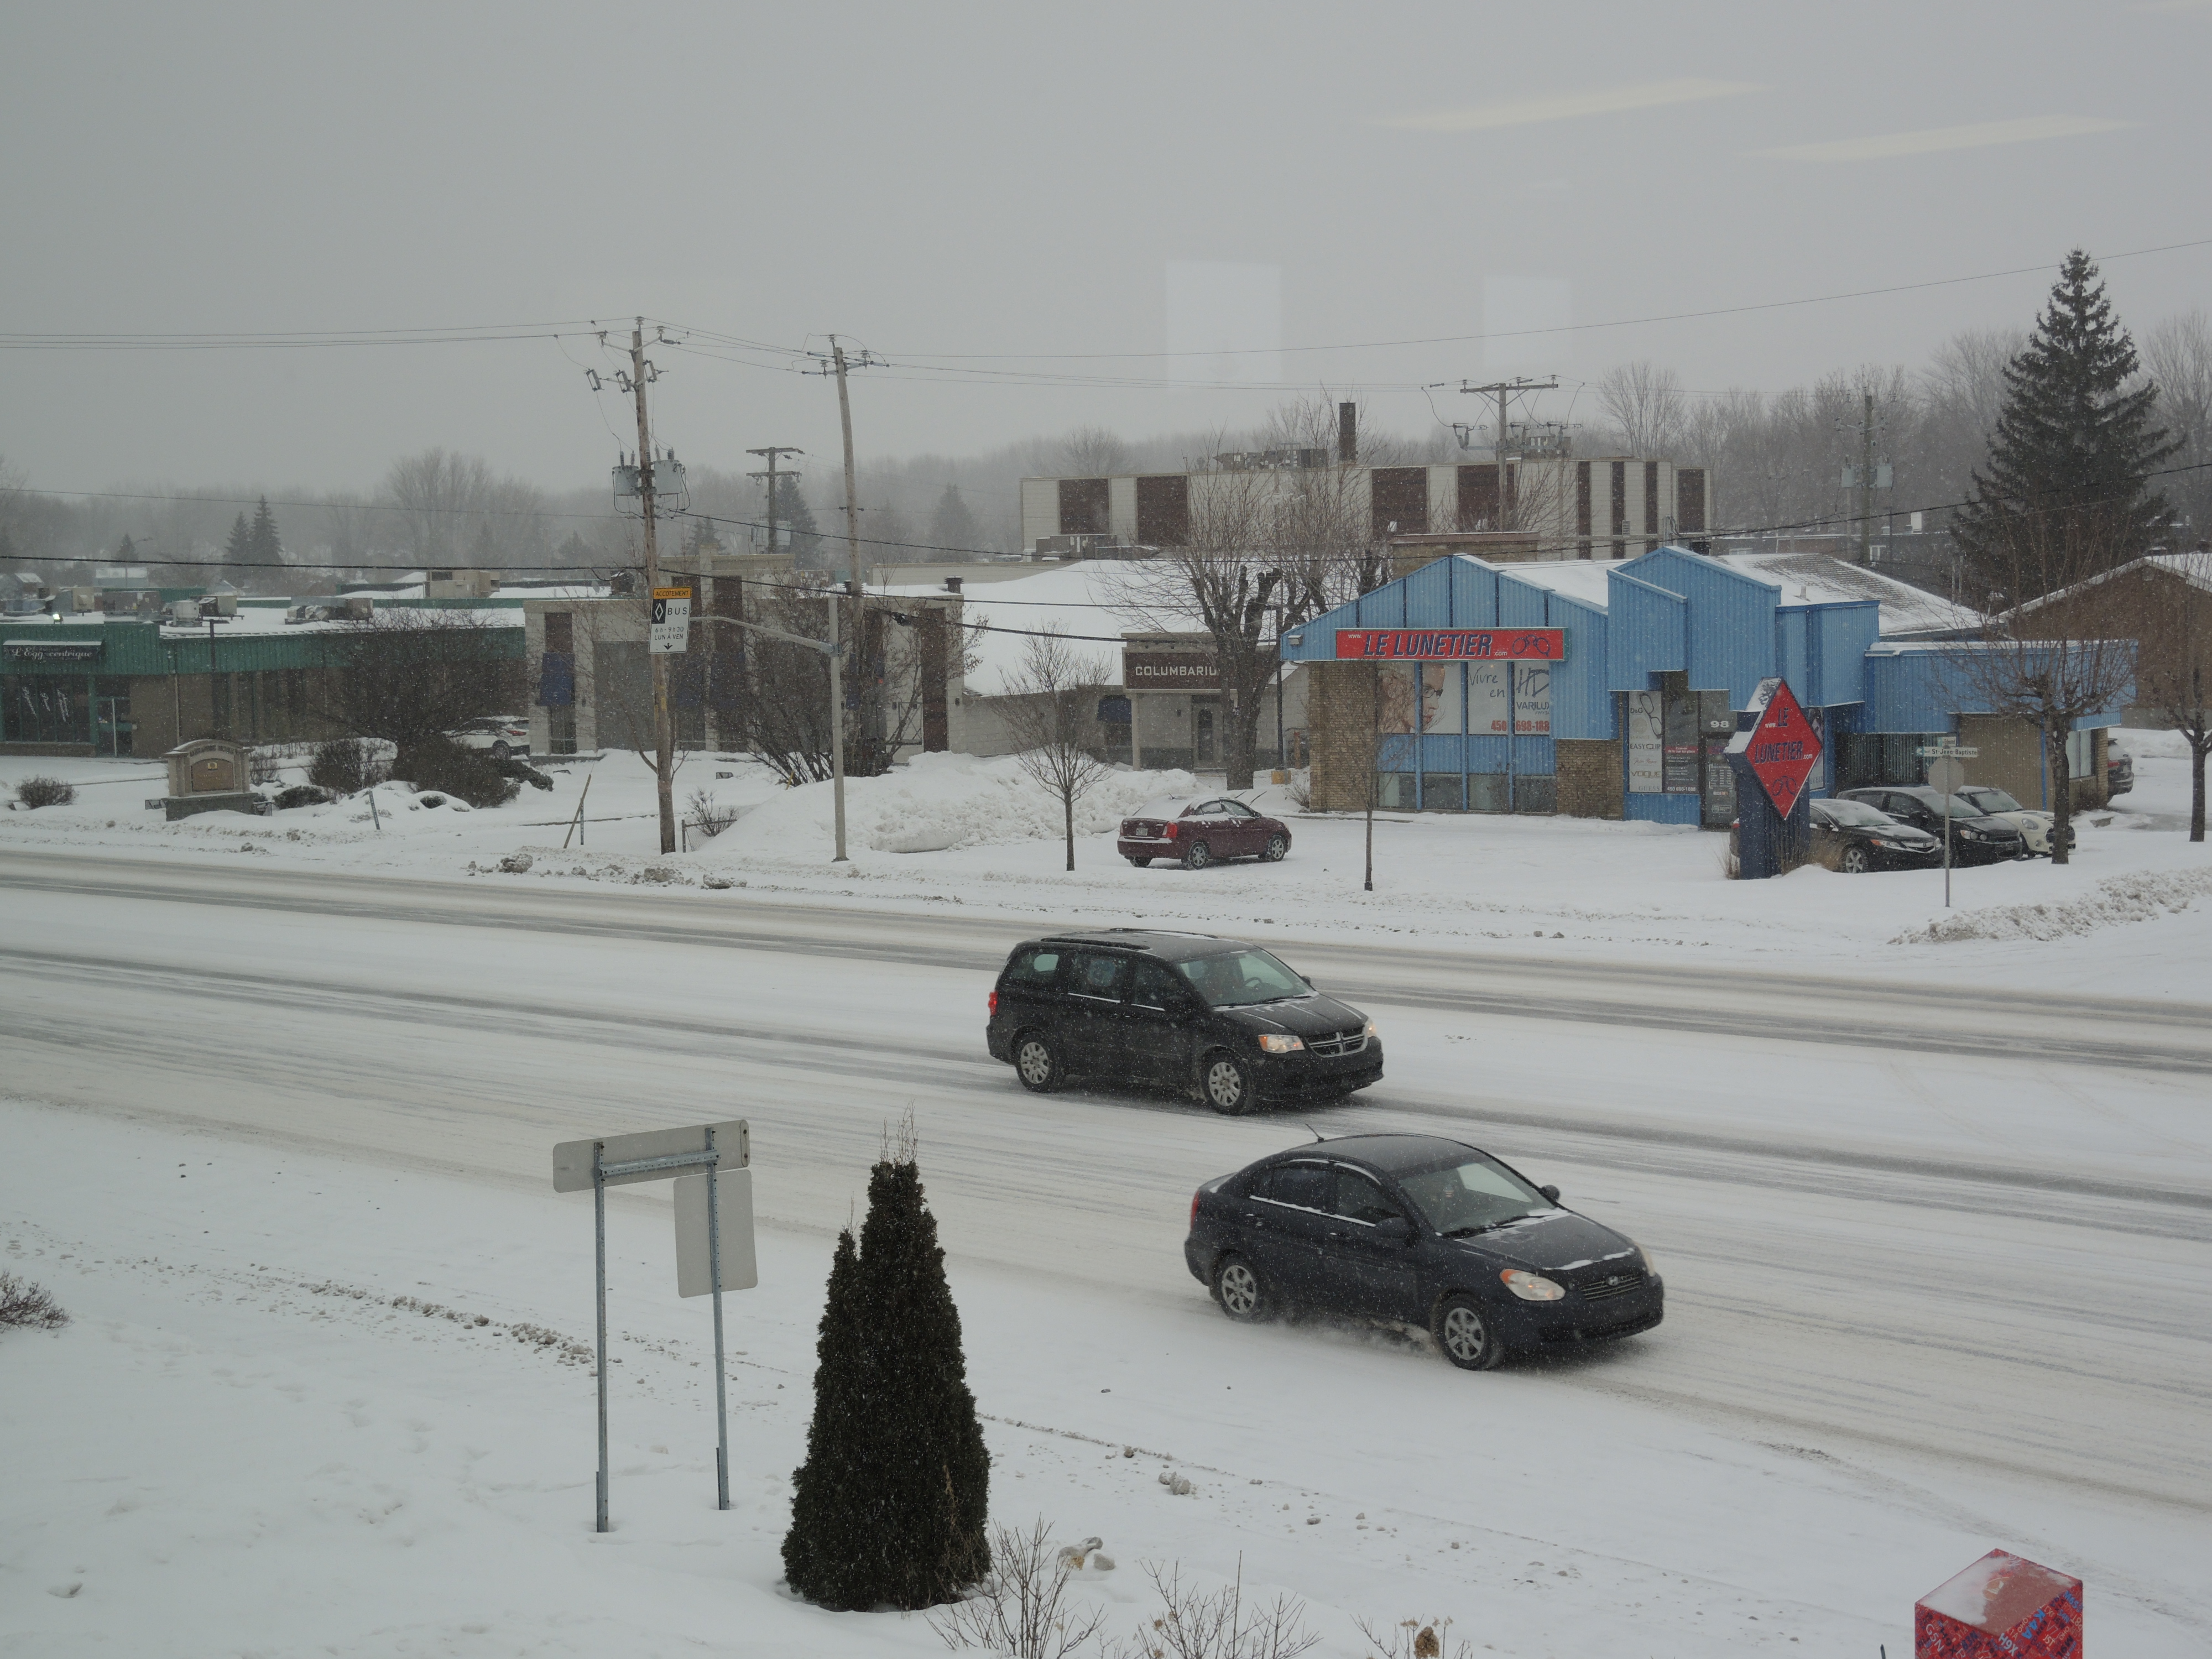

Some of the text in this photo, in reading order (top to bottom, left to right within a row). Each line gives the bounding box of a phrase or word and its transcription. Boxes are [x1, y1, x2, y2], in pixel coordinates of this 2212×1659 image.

[1364, 634, 1389, 656] LE
[1393, 634, 1493, 657] LUNETIER
[1135, 666, 1220, 675] COLUMBARIU
[1469, 665, 1499, 686] Vivre
[1489, 688, 1505, 697] en
[1490, 720, 1507, 732] 450
[1710, 720, 1729, 728] 98
[1777, 708, 1790, 727] LE
[1755, 741, 1803, 764] LUNETIER
[1998, 1632, 2019, 1657] H9X
